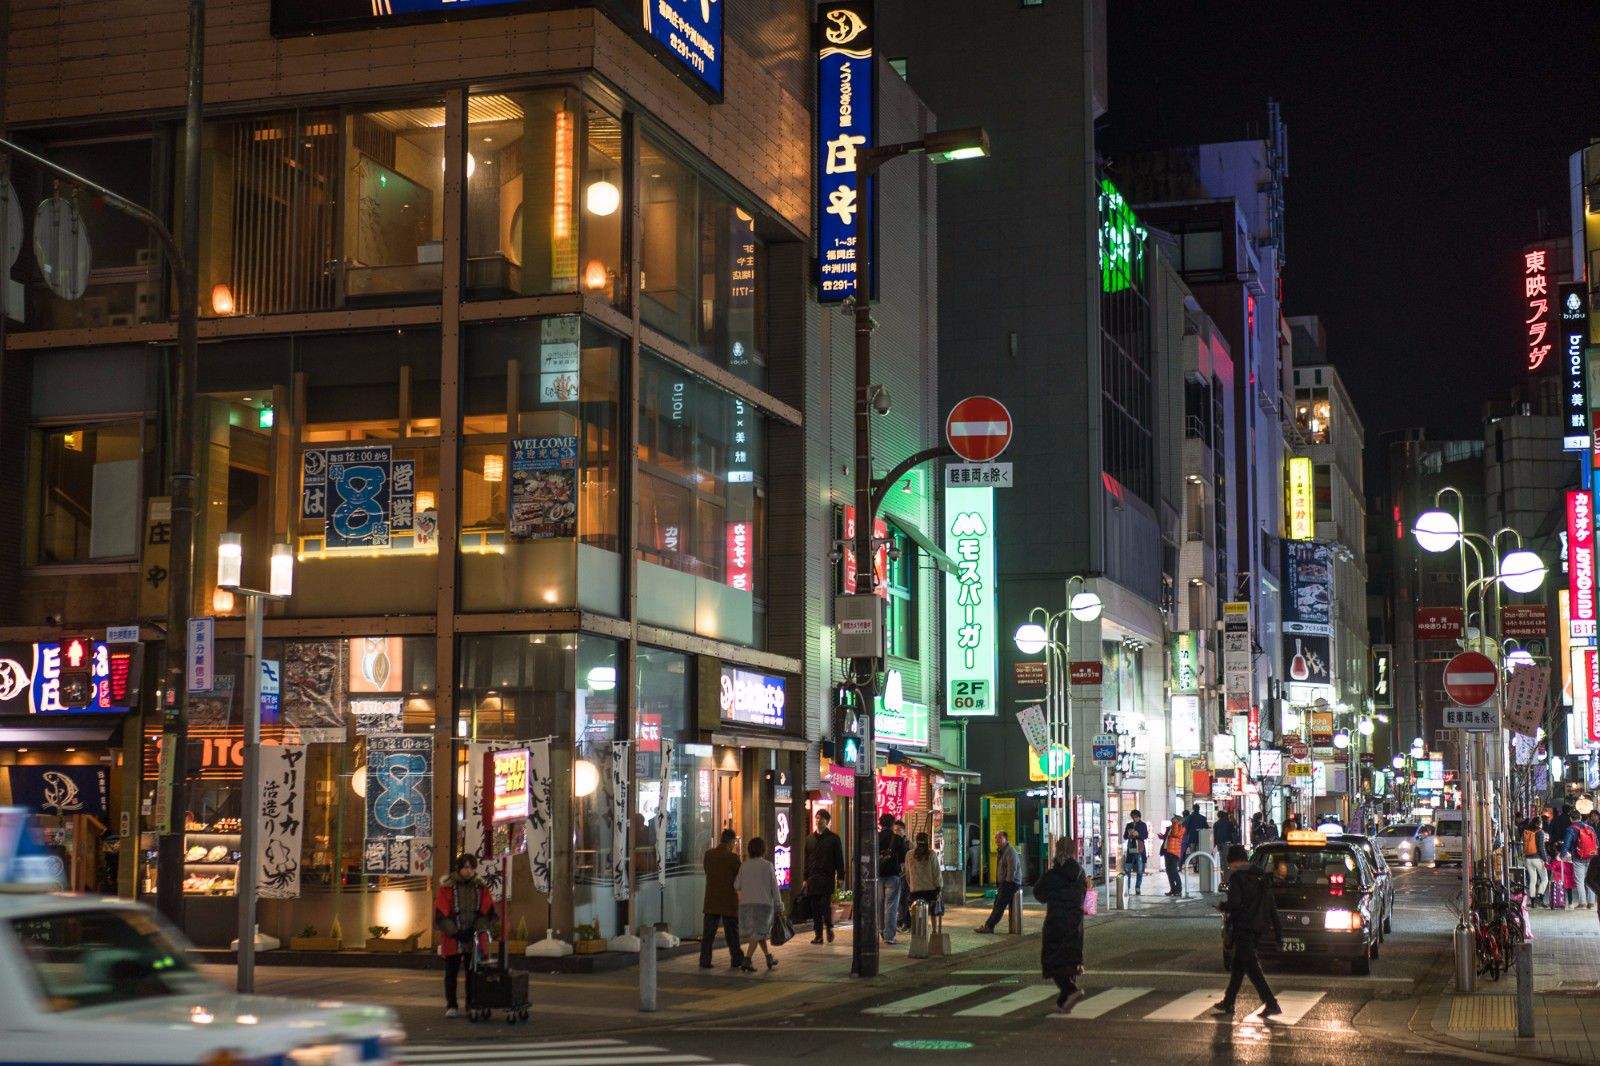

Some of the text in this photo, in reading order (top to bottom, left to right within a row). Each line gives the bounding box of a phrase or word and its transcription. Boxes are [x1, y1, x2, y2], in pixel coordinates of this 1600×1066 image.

[1525, 250, 1550, 370] 東映プラザ
[1570, 335, 1582, 375] bijou
[513, 436, 576, 449] WELCOME
[392, 463, 414, 526] 営業
[949, 467, 1008, 484] 軽車両を除く
[304, 488, 325, 515] は
[1575, 493, 1590, 542] カラオケ
[957, 538, 982, 670] モスバーガー
[954, 697, 986, 710] 60席
[956, 682, 984, 695] 2F
[1446, 710, 1496, 724] 軽車両を除く
[262, 780, 281, 836] 活造り
[280, 747, 303, 837] ヤリイカ
